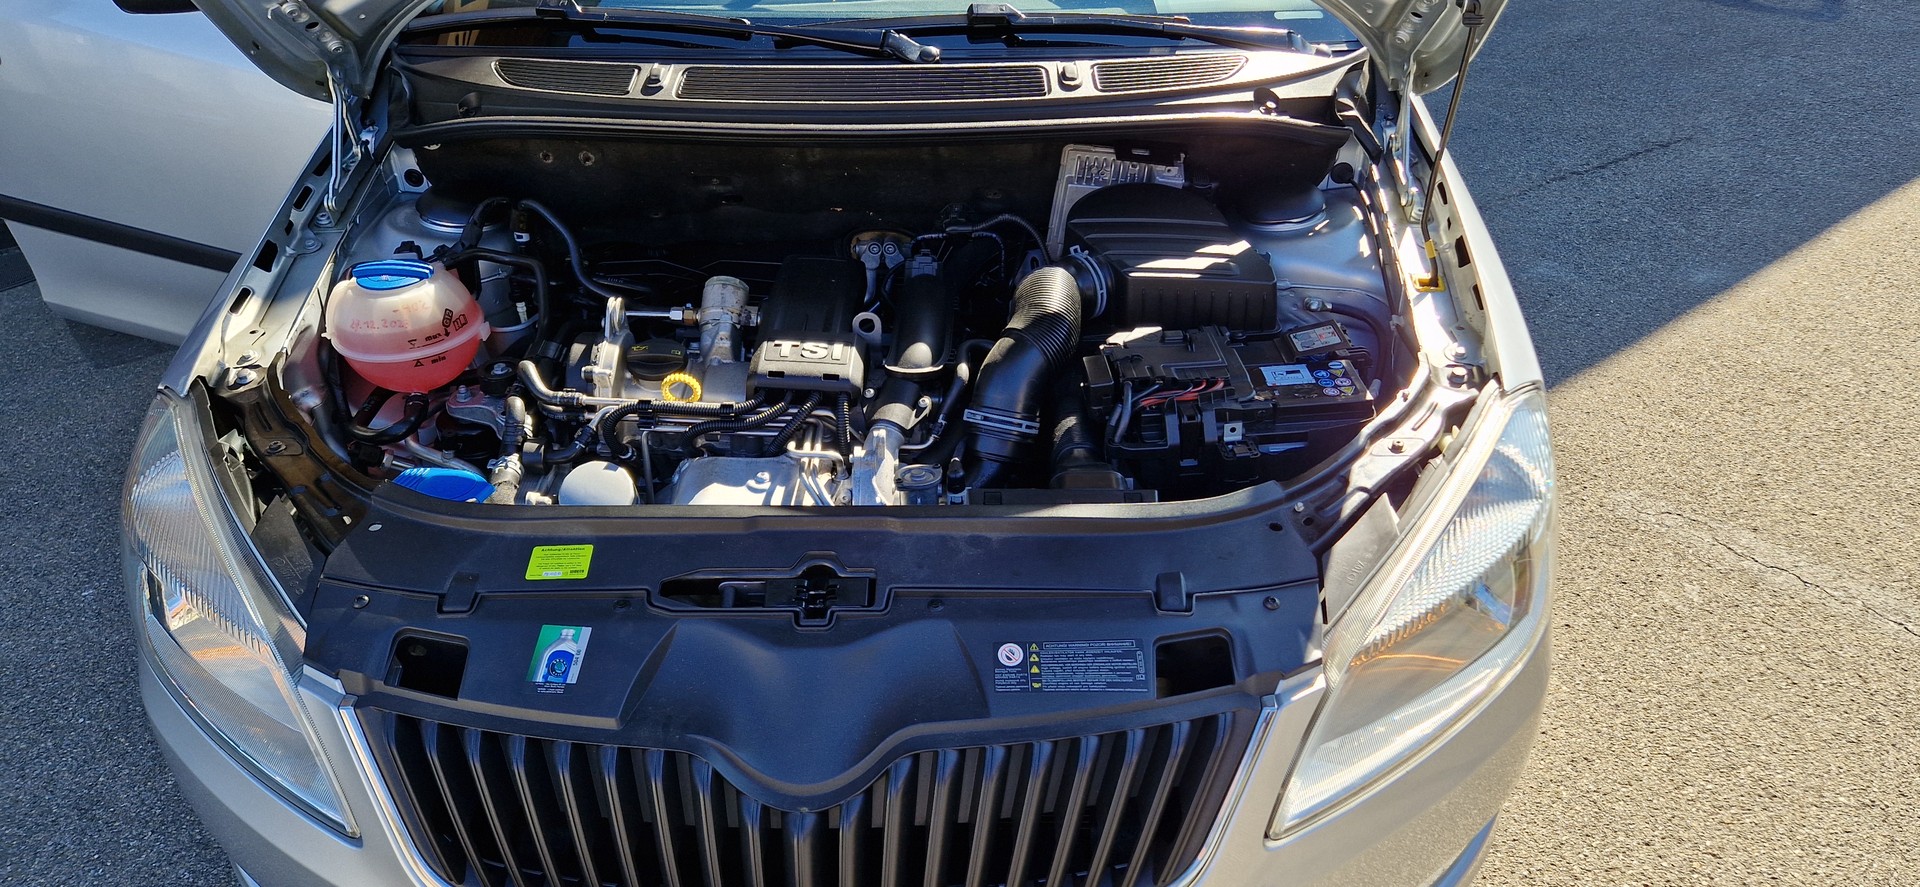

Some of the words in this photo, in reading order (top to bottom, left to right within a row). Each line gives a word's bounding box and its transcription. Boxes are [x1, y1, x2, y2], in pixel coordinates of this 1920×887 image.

[444, 310, 452, 326] G12
[425, 333, 442, 341] max
[774, 340, 843, 360] TSI
[431, 356, 446, 364] min
